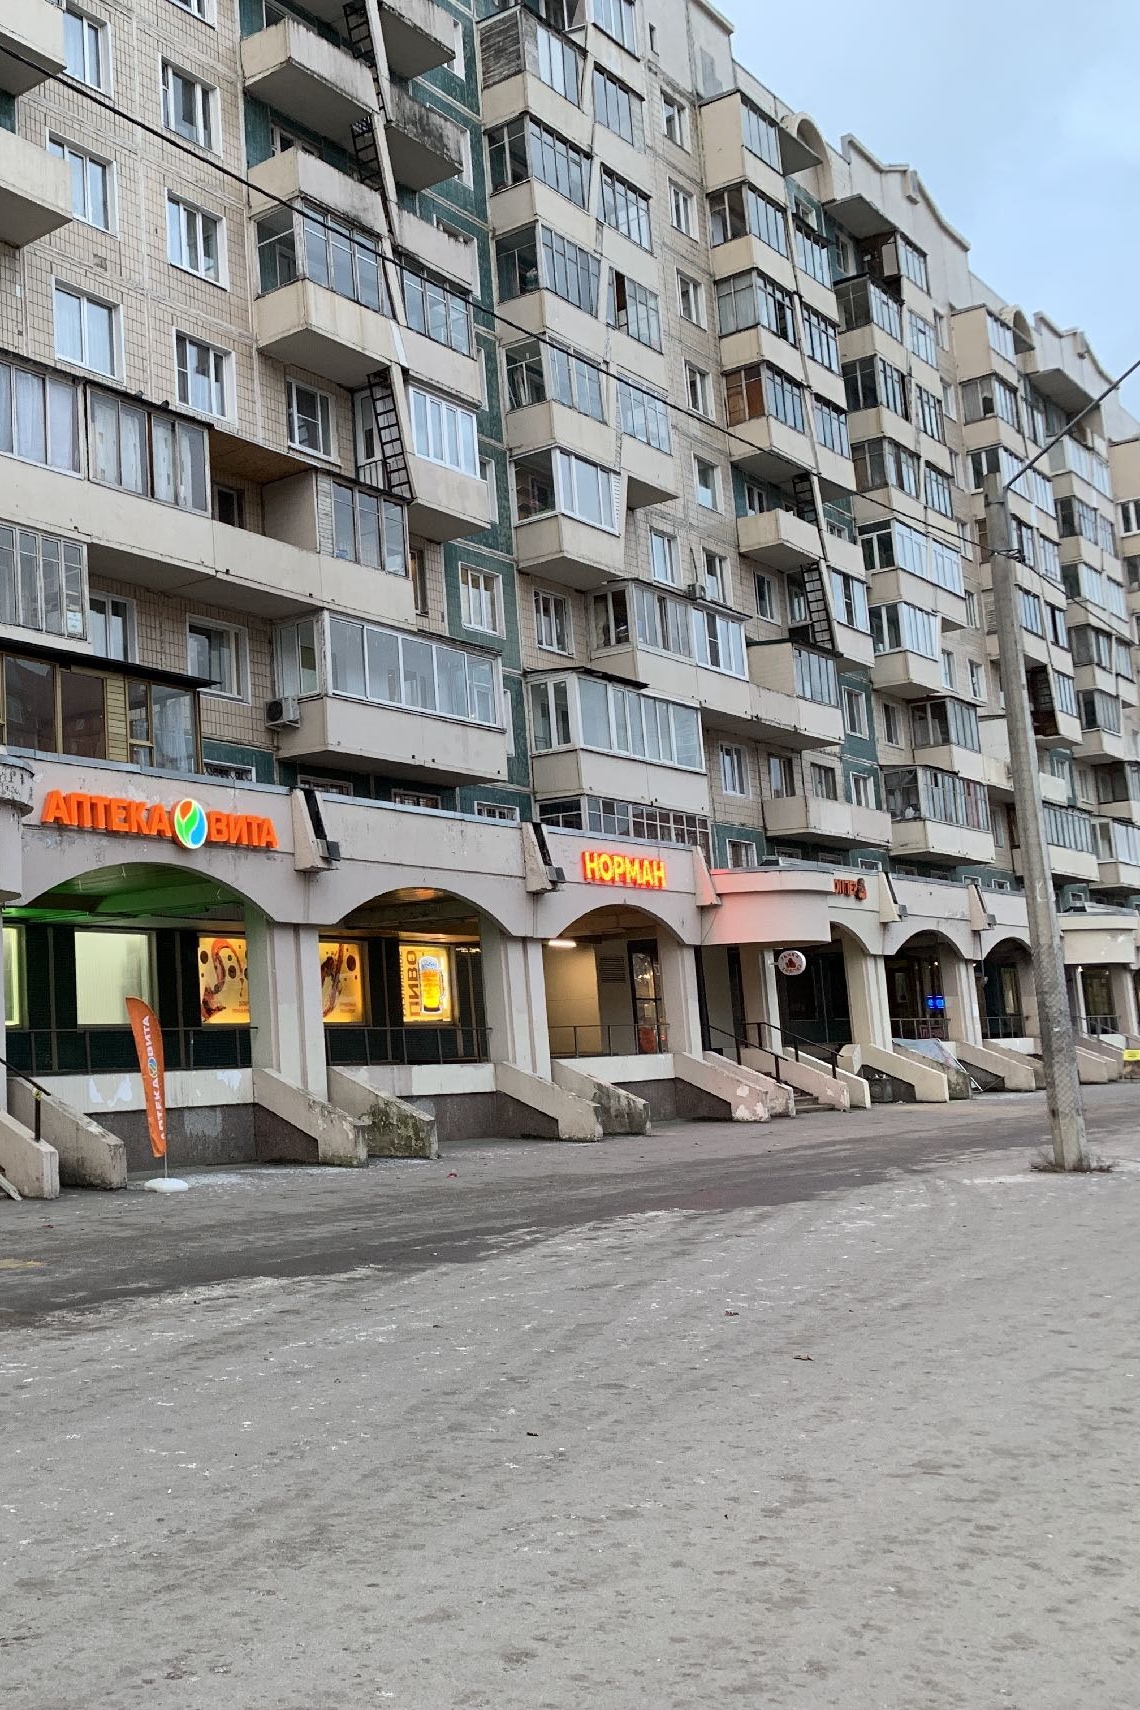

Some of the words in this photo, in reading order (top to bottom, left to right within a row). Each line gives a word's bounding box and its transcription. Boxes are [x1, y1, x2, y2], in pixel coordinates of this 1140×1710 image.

[41, 789, 172, 836] АПТЕКА
[207, 810, 278, 848] ВИТА
[582, 851, 667, 888] НОРМАН
[407, 951, 420, 1017] ПИВО
[142, 1015, 156, 1058] ВИТА
